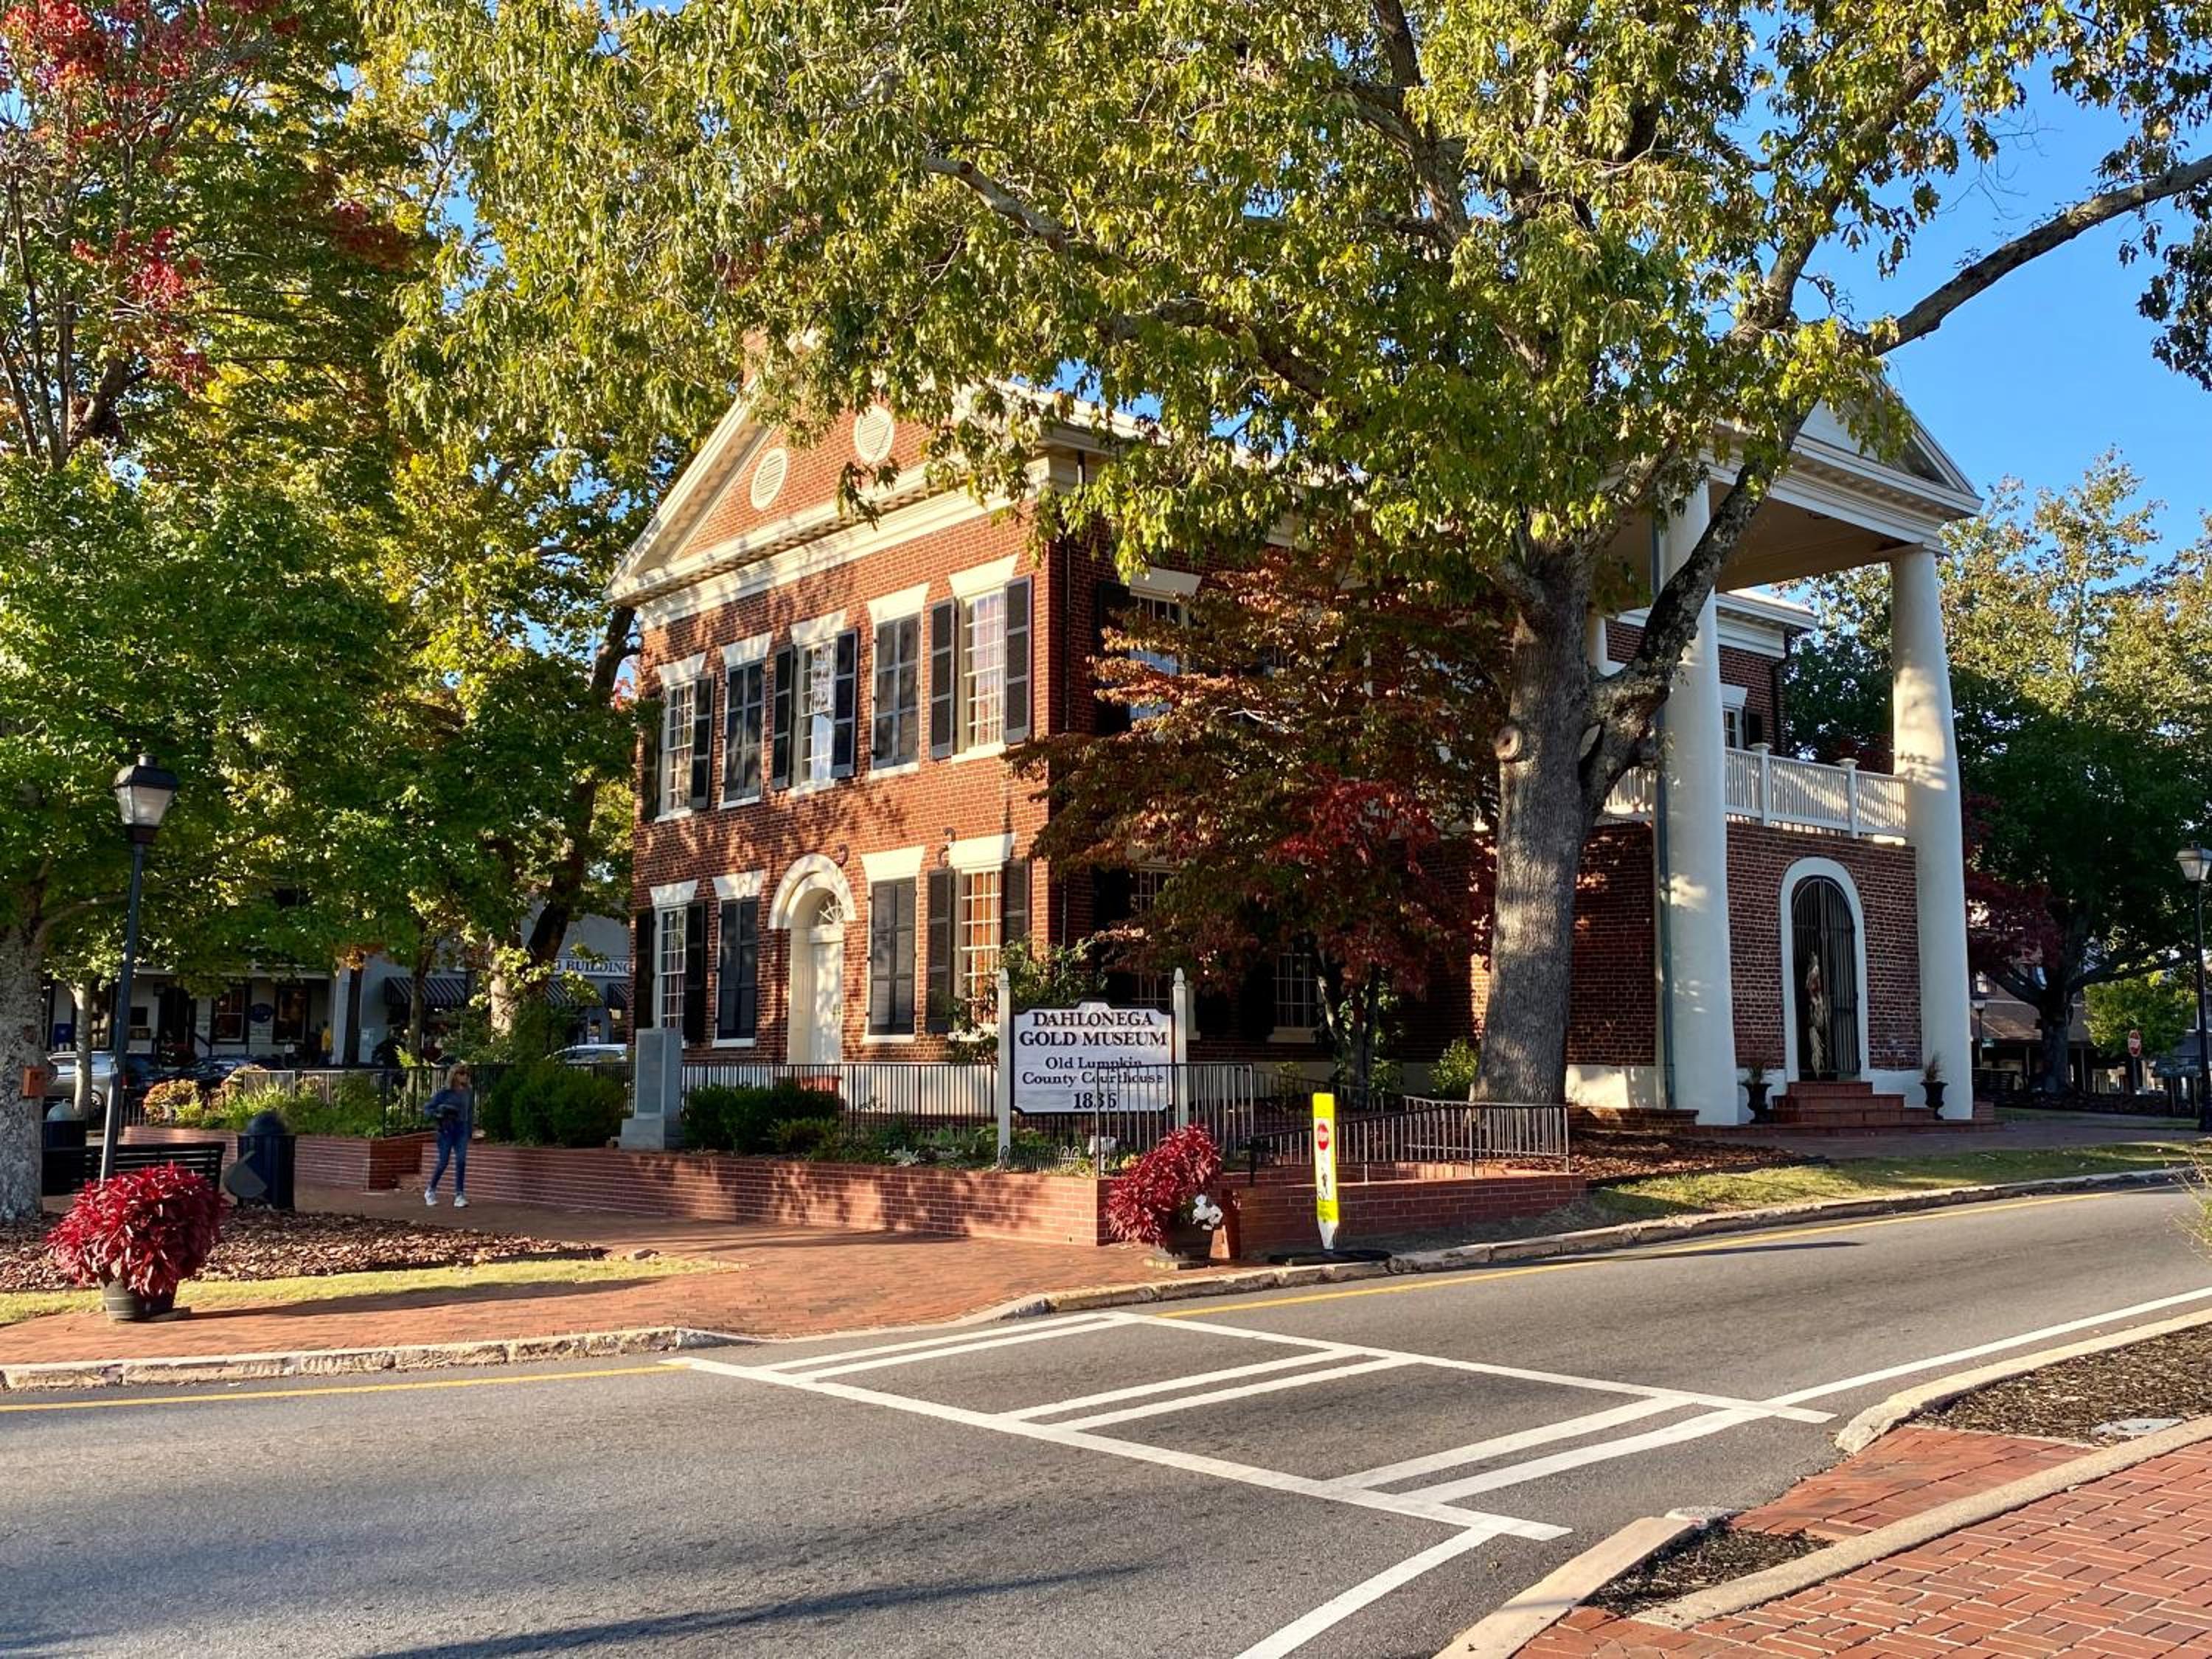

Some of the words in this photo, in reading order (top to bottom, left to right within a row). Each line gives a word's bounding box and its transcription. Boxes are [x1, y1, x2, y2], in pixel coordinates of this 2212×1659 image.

[1034, 1012, 1153, 1026] DAHLONEGA
[1019, 1031, 1077, 1046] GOLD
[1082, 1032, 1166, 1046] MUSEUM
[1046, 1057, 1074, 1069] Old
[1078, 1057, 1141, 1072] Lumpkin
[1023, 1071, 1077, 1088] County
[1082, 1071, 1164, 1085] Courthouse
[1074, 1092, 1117, 1109] 1836
